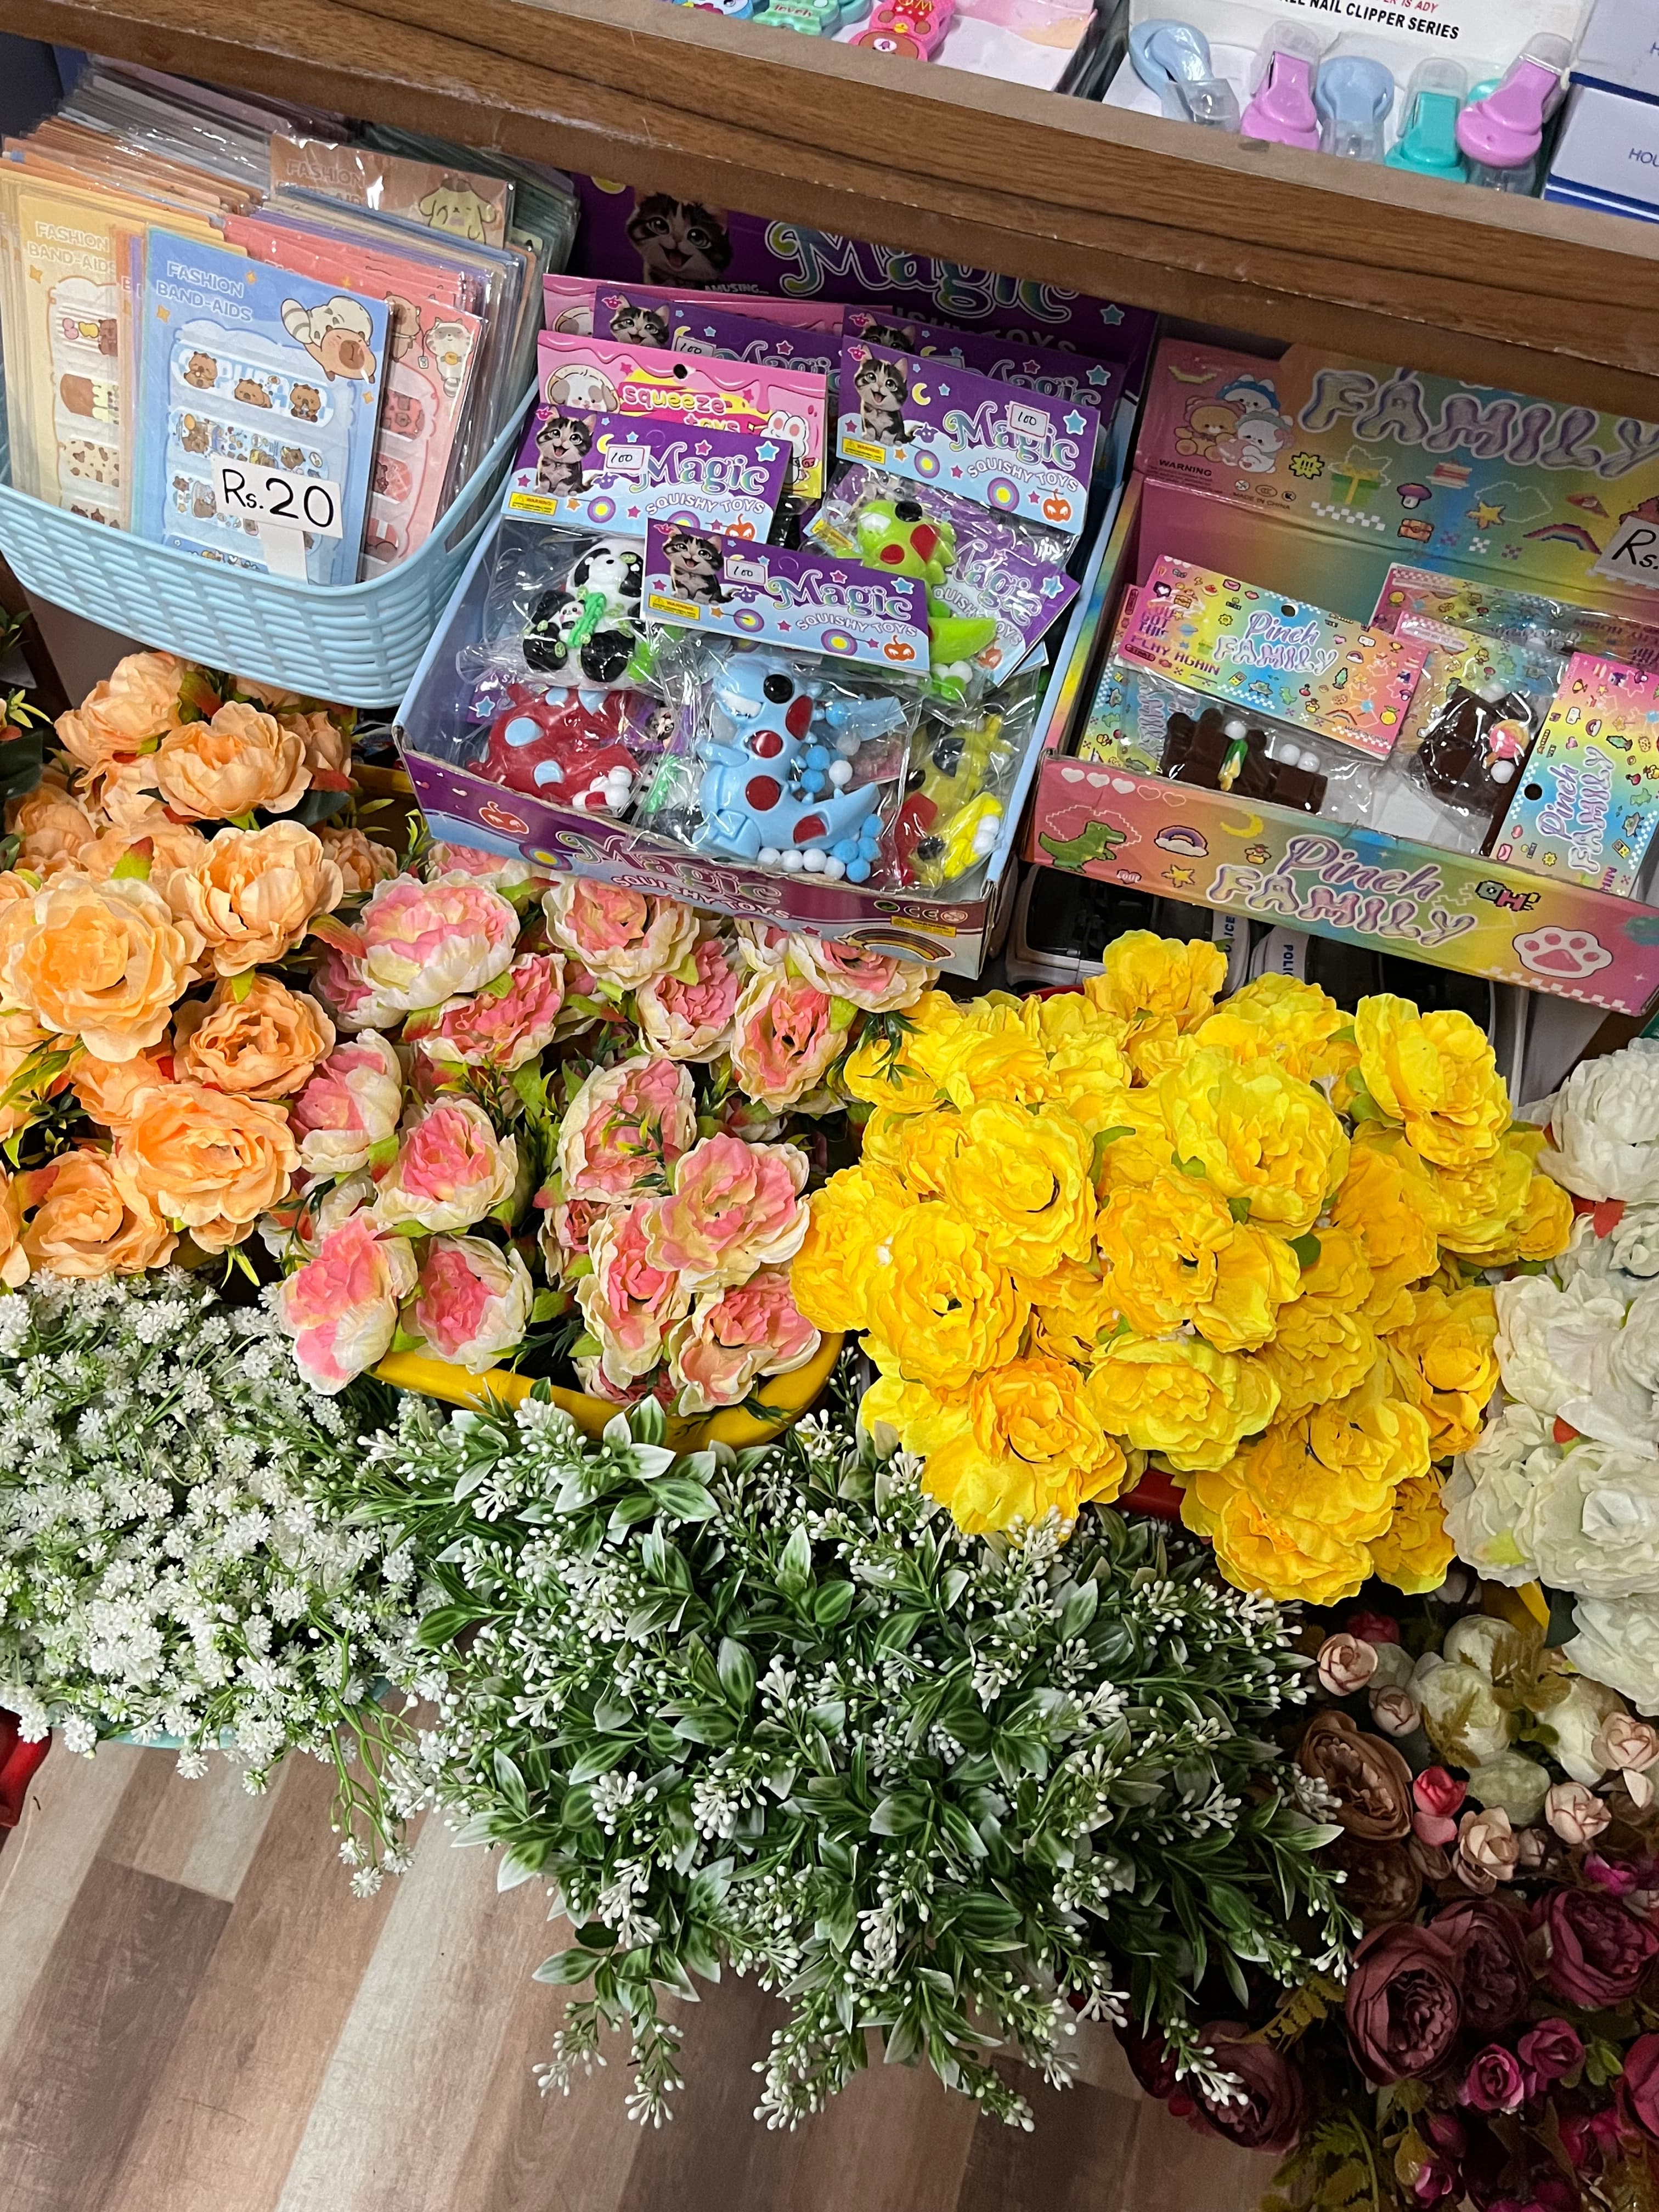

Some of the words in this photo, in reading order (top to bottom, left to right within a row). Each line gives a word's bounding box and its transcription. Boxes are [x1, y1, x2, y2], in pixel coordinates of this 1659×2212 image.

[1310, 0, 1341, 13] NAIL
[1346, 3, 1406, 27] CLIPPER
[1408, 17, 1459, 39] SERIES
[1414, 1, 1438, 13] ADY
[286, 158, 366, 188] FASHION
[35, 221, 109, 252] FASHION
[167, 261, 244, 298] FASHION
[156, 280, 252, 321] BAND-AIDS
[680, 342, 702, 355] 100
[622, 384, 727, 415] squeeze
[1017, 411, 1037, 427] 100
[1299, 369, 1659, 479] FAMILY
[610, 453, 633, 464] 100
[629, 442, 769, 495] Magic
[968, 458, 1033, 483] SQUISHY
[1036, 472, 1079, 492] TOYS
[1159, 459, 1212, 477] WARNING
[646, 492, 718, 516] SQUISHY
[720, 499, 765, 515] TOYS
[1611, 529, 1659, 569] Rs.
[733, 566, 753, 577] 100
[766, 569, 913, 620] Magic
[795, 613, 869, 633] SQUISHY
[871, 621, 917, 636] TOYS
[1244, 610, 1321, 646] Pinch
[1213, 636, 1339, 675] FAMILY
[1536, 764, 1581, 842] Pinch
[1568, 745, 1615, 874] FAMILY
[555, 831, 782, 905] Magic
[1276, 834, 1443, 901] Pinch
[611, 875, 714, 905] SQUISHY
[720, 898, 791, 920] TOYS
[1206, 864, 1479, 948] FAMILY
